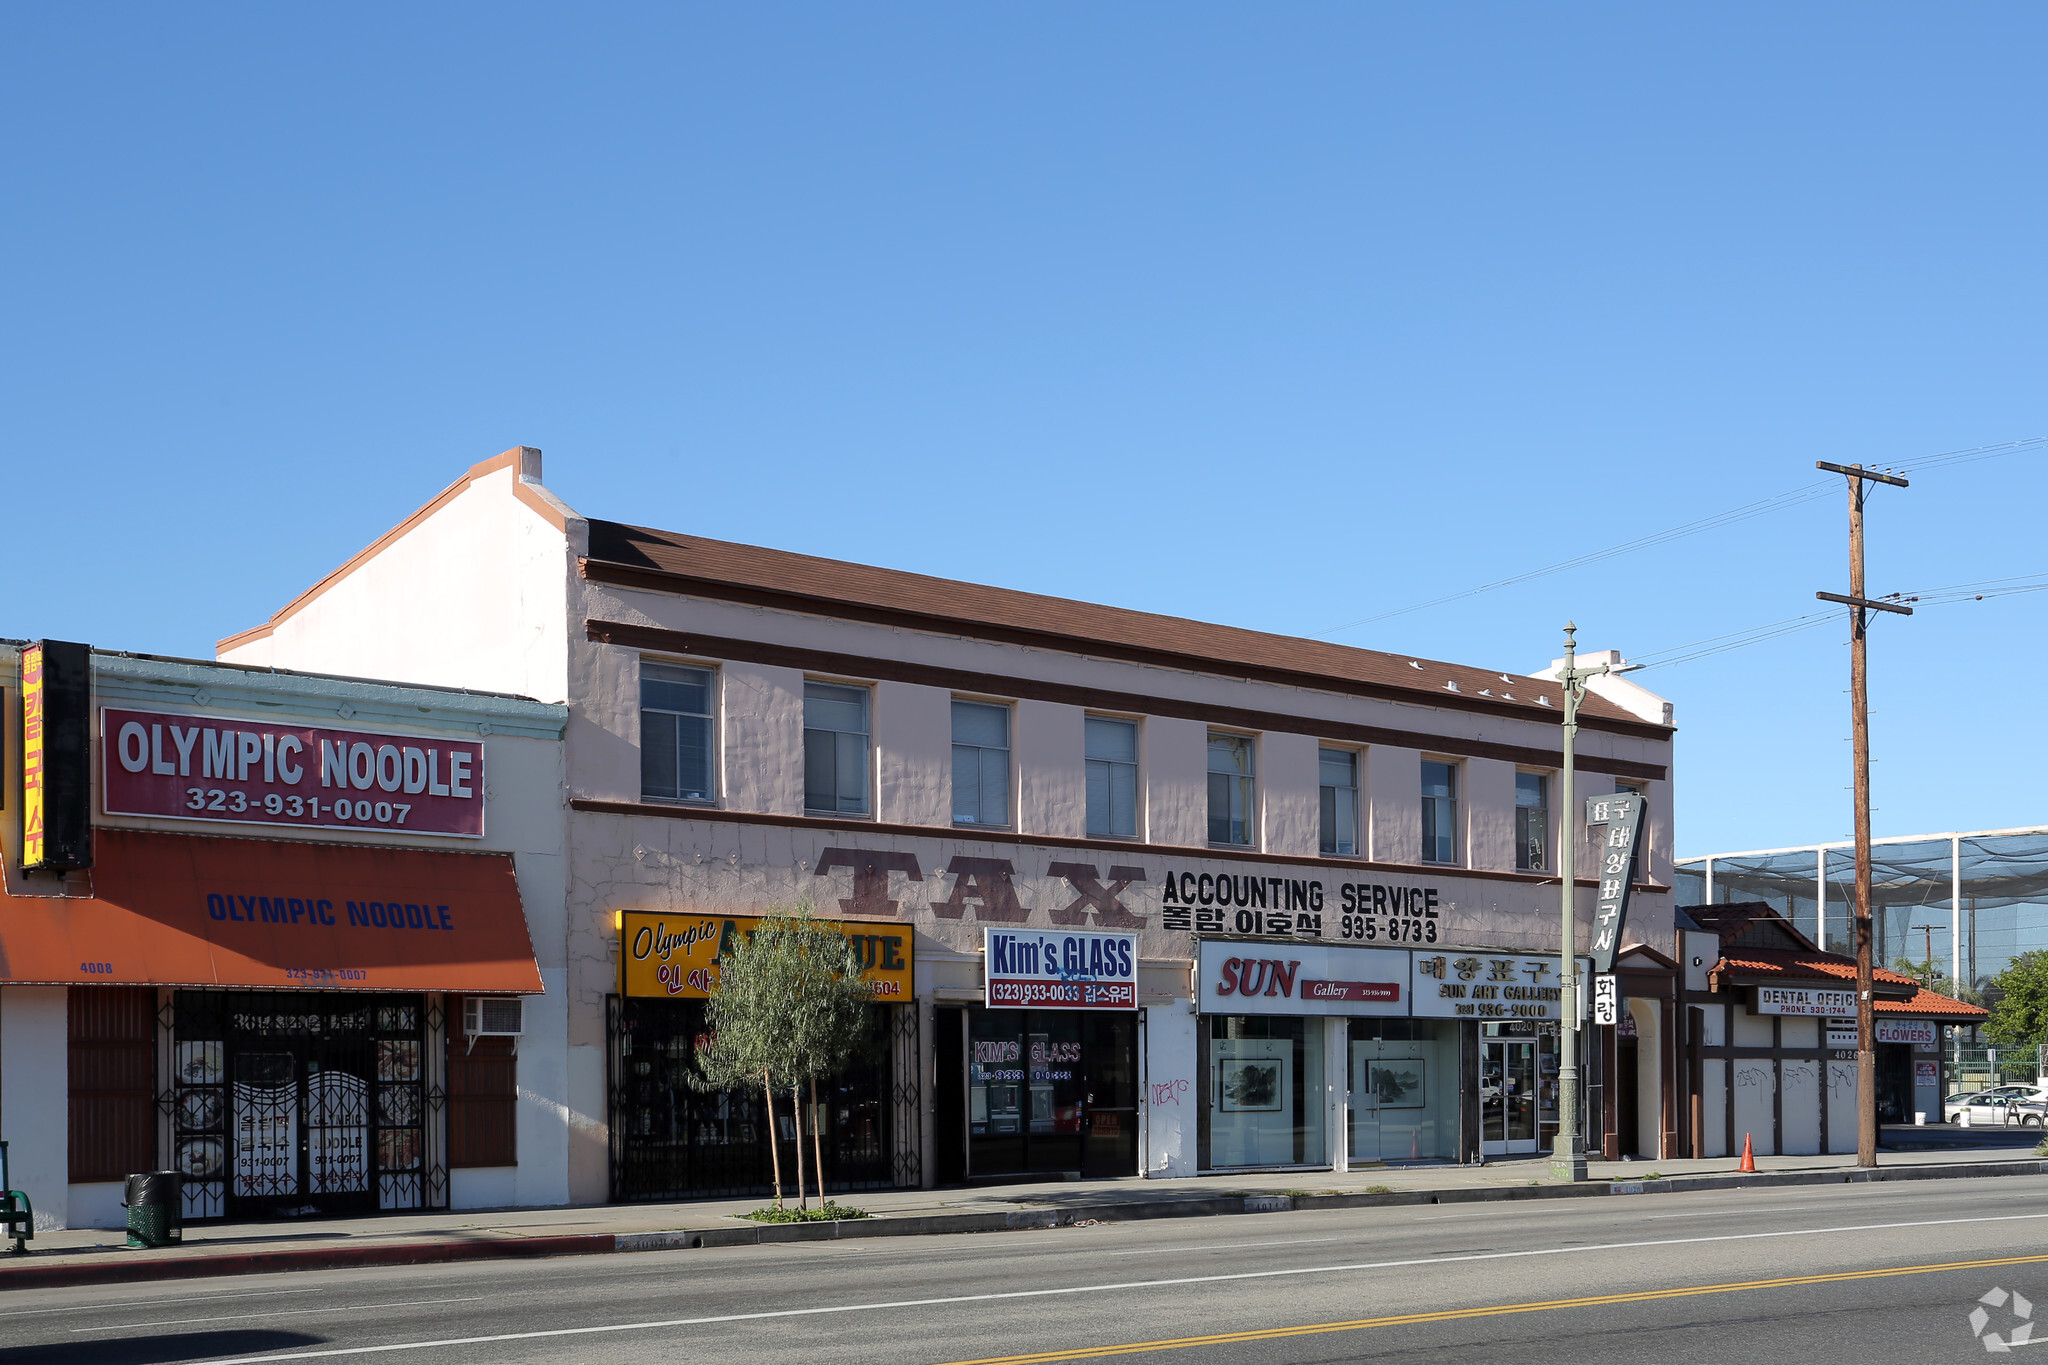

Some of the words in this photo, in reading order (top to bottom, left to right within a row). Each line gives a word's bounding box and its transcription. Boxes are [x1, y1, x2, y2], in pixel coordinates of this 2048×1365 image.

[118, 721, 304, 785] OLYMPIC
[321, 738, 473, 800] NOODLE
[186, 787, 412, 825] 323-931-0007
[814, 847, 1148, 928] TAX
[1163, 870, 1324, 912] ACCOUNTING
[1341, 882, 1439, 919] SERVICE
[207, 893, 335, 926] OLYMPIC
[347, 901, 454, 931] NOODLE
[1341, 915, 1437, 944] 935-8733
[633, 919, 717, 962] Olympic
[993, 935, 1059, 976] Kim's
[1062, 936, 1132, 978] GLASS
[80, 962, 113, 974] 4008
[286, 967, 367, 981] 323-931-0007
[1217, 957, 1301, 998] SUN
[991, 983, 1080, 1002] (323)933-0033
[1313, 983, 1349, 1000] Gallery
[1439, 983, 1467, 998] SUN
[1472, 985, 1499, 1000] ART
[1596, 978, 1615, 1022] 화랑
[1763, 990, 1812, 1005] DENTAL
[1478, 1004, 1548, 1017] 936-9000
[1780, 1005, 1806, 1013] PHONE
[1810, 1006, 1846, 1014] 930-1744
[1509, 1021, 1533, 1032] 4020
[1880, 1028, 1932, 1042] FLOWERS
[974, 1041, 1019, 1063] KIM'S
[1029, 1041, 1081, 1063] GLASS
[1835, 1050, 1858, 1060] 4026
[240, 1156, 290, 1168] 931-0007
